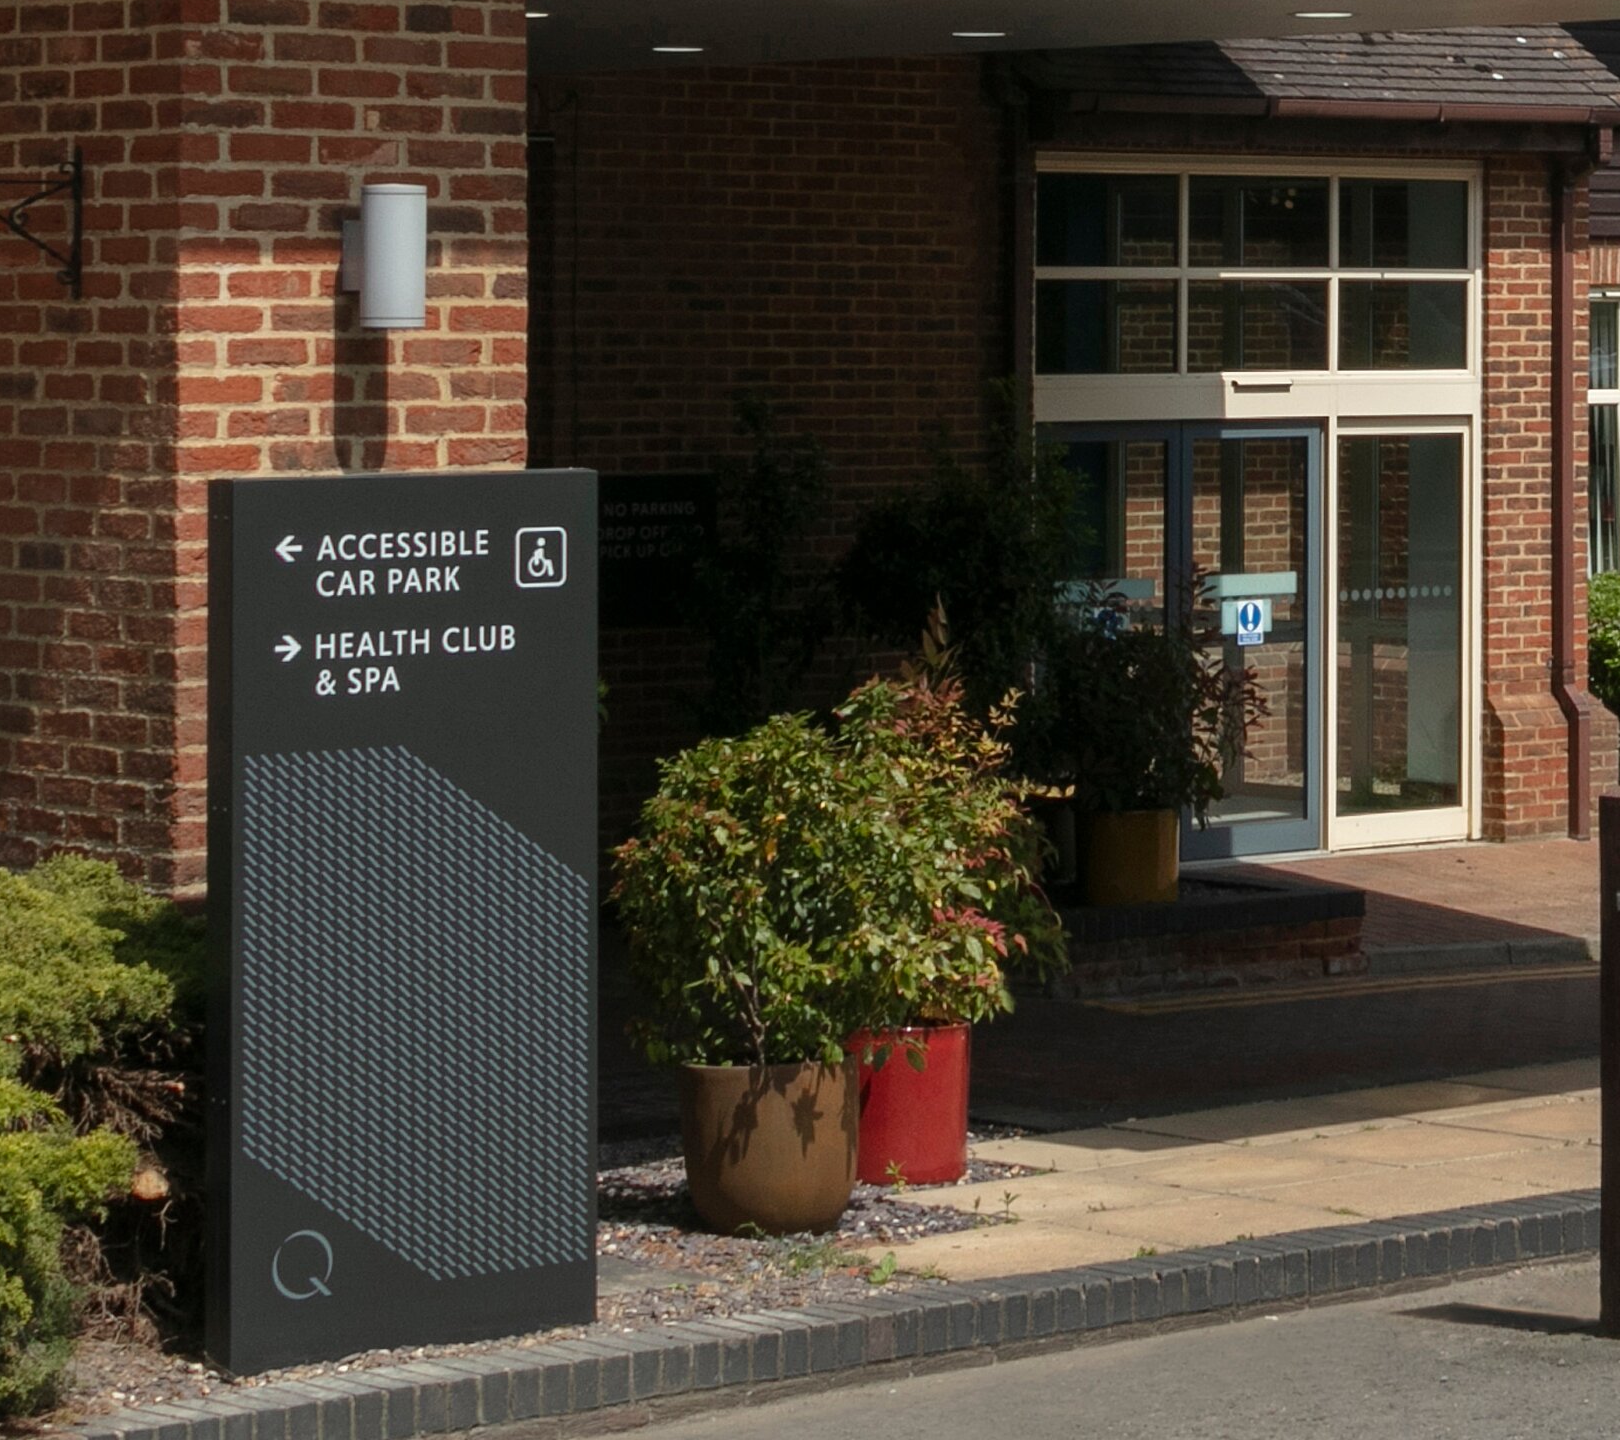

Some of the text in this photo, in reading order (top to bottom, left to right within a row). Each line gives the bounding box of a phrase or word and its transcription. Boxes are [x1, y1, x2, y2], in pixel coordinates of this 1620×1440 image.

[603, 501, 696, 517] NO PARKING
[317, 529, 490, 562] ACCESSIBLE
[636, 543, 656, 559] UP
[316, 566, 461, 597] CAR PARK
[315, 625, 516, 660] HEALTH CLUB
[315, 666, 401, 696] & SPA
[272, 1229, 333, 1300] Q
